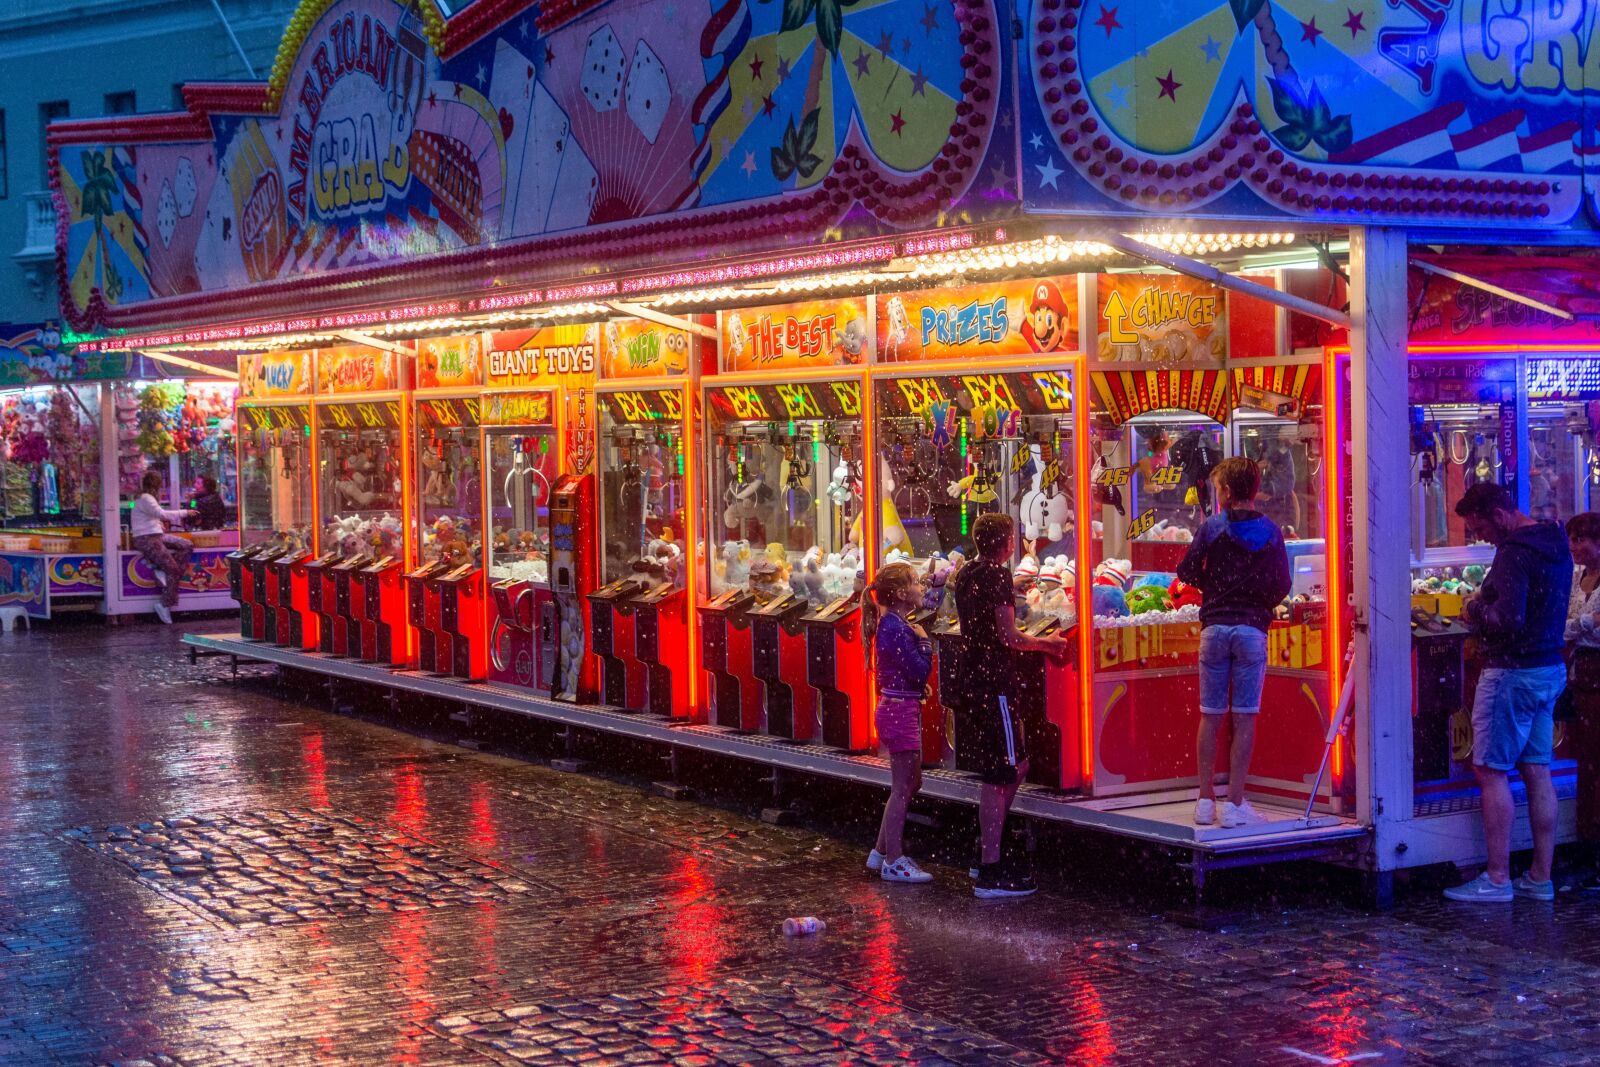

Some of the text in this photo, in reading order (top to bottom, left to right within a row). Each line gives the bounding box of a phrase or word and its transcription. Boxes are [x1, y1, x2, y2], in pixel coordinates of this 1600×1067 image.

[288, 11, 396, 226] AMERICAN
[313, 92, 414, 217] GRAB
[1036, 283, 1049, 300] M
[1131, 286, 1216, 331] CHANGE
[747, 313, 837, 363] THE BEST
[336, 356, 376, 391] CRANES
[440, 350, 464, 377] XXL
[489, 344, 595, 377] GIANT TOYS
[1465, 364, 1487, 379] iPad
[265, 363, 295, 392] LUCKY
[962, 374, 1022, 414] EX1
[328, 403, 357, 428] EX1
[356, 402, 386, 427] EX1
[613, 391, 656, 421] EX1
[724, 386, 770, 419] EX1
[776, 383, 824, 418] EX1
[577, 387, 587, 470] CHANGE
[970, 407, 1023, 440] TOYS
[1503, 405, 1514, 457] iPhone
[1010, 442, 1031, 475] 46
[1040, 458, 1062, 490] 46
[1096, 466, 1131, 487] 46
[1150, 466, 1184, 486] 46
[1126, 507, 1156, 541] 46
[1453, 726, 1468, 744] IN
